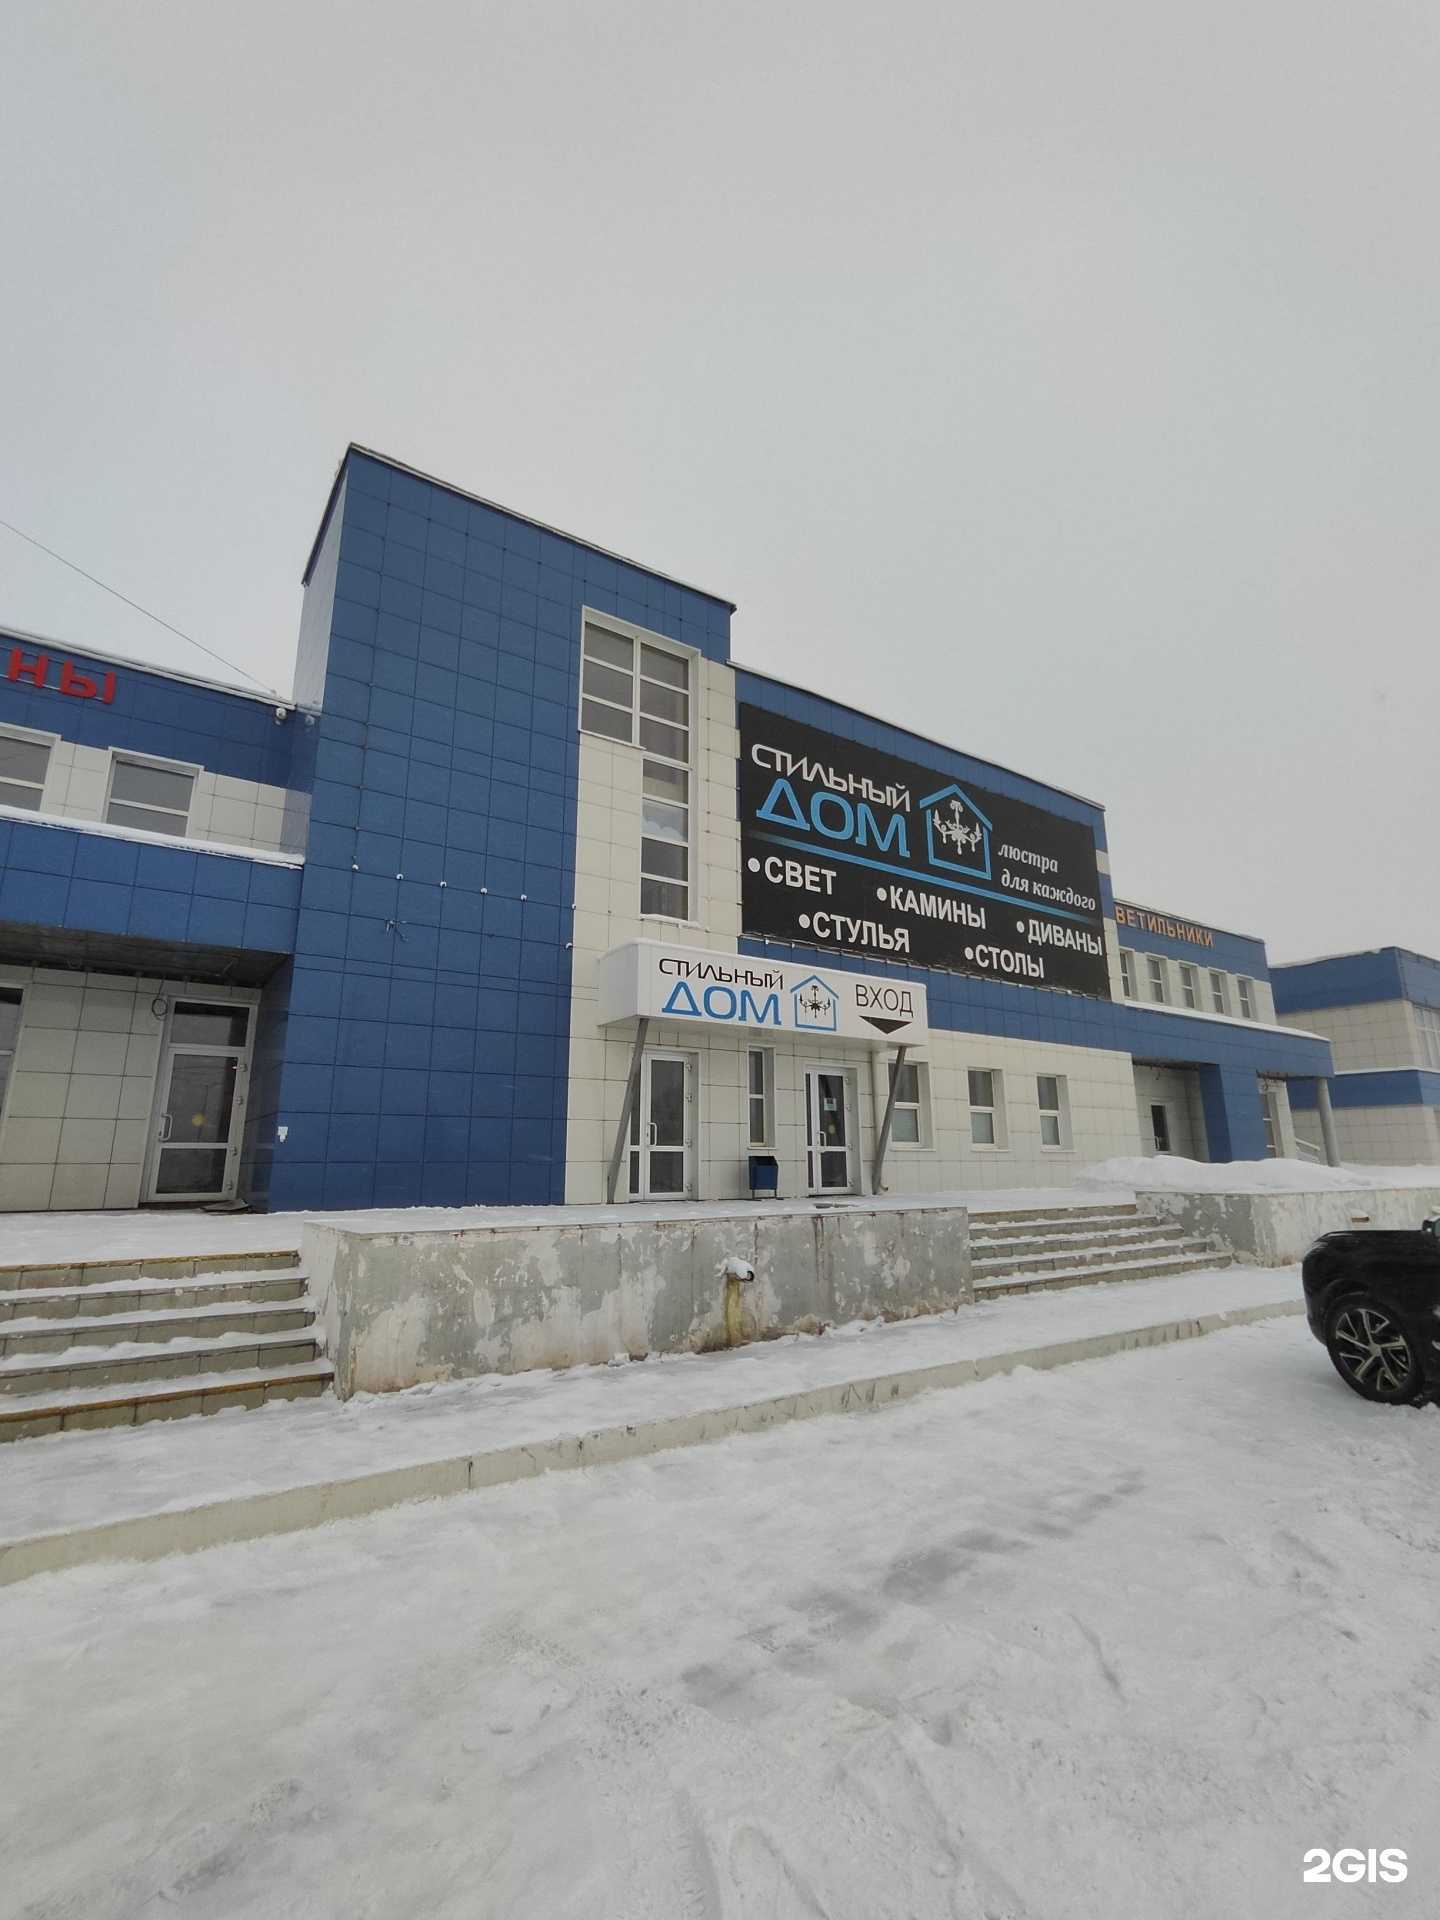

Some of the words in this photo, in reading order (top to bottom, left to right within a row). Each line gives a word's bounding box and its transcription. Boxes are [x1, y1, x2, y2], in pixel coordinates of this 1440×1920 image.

[8, 648, 116, 704] НЫ
[751, 743, 911, 812] СТИЛЬНЫЙ
[756, 778, 910, 858] ДОМ
[765, 856, 837, 895] СВЕТ
[998, 843, 1059, 873] люстра
[890, 885, 986, 930] КАМИНЫ
[1001, 868, 1029, 893] для
[1032, 881, 1096, 911] каждого
[813, 911, 910, 953] СТУЛЬЯ
[1028, 919, 1102, 956] ДИВАНЫ
[1115, 904, 1214, 947] ВЕТИЛЬНИКИ
[659, 958, 783, 990] СТИЛЬНЫЙ
[975, 944, 1044, 979] СТОЛЫ
[662, 981, 782, 1026] ДОМ
[856, 984, 914, 1018] ВХОД
